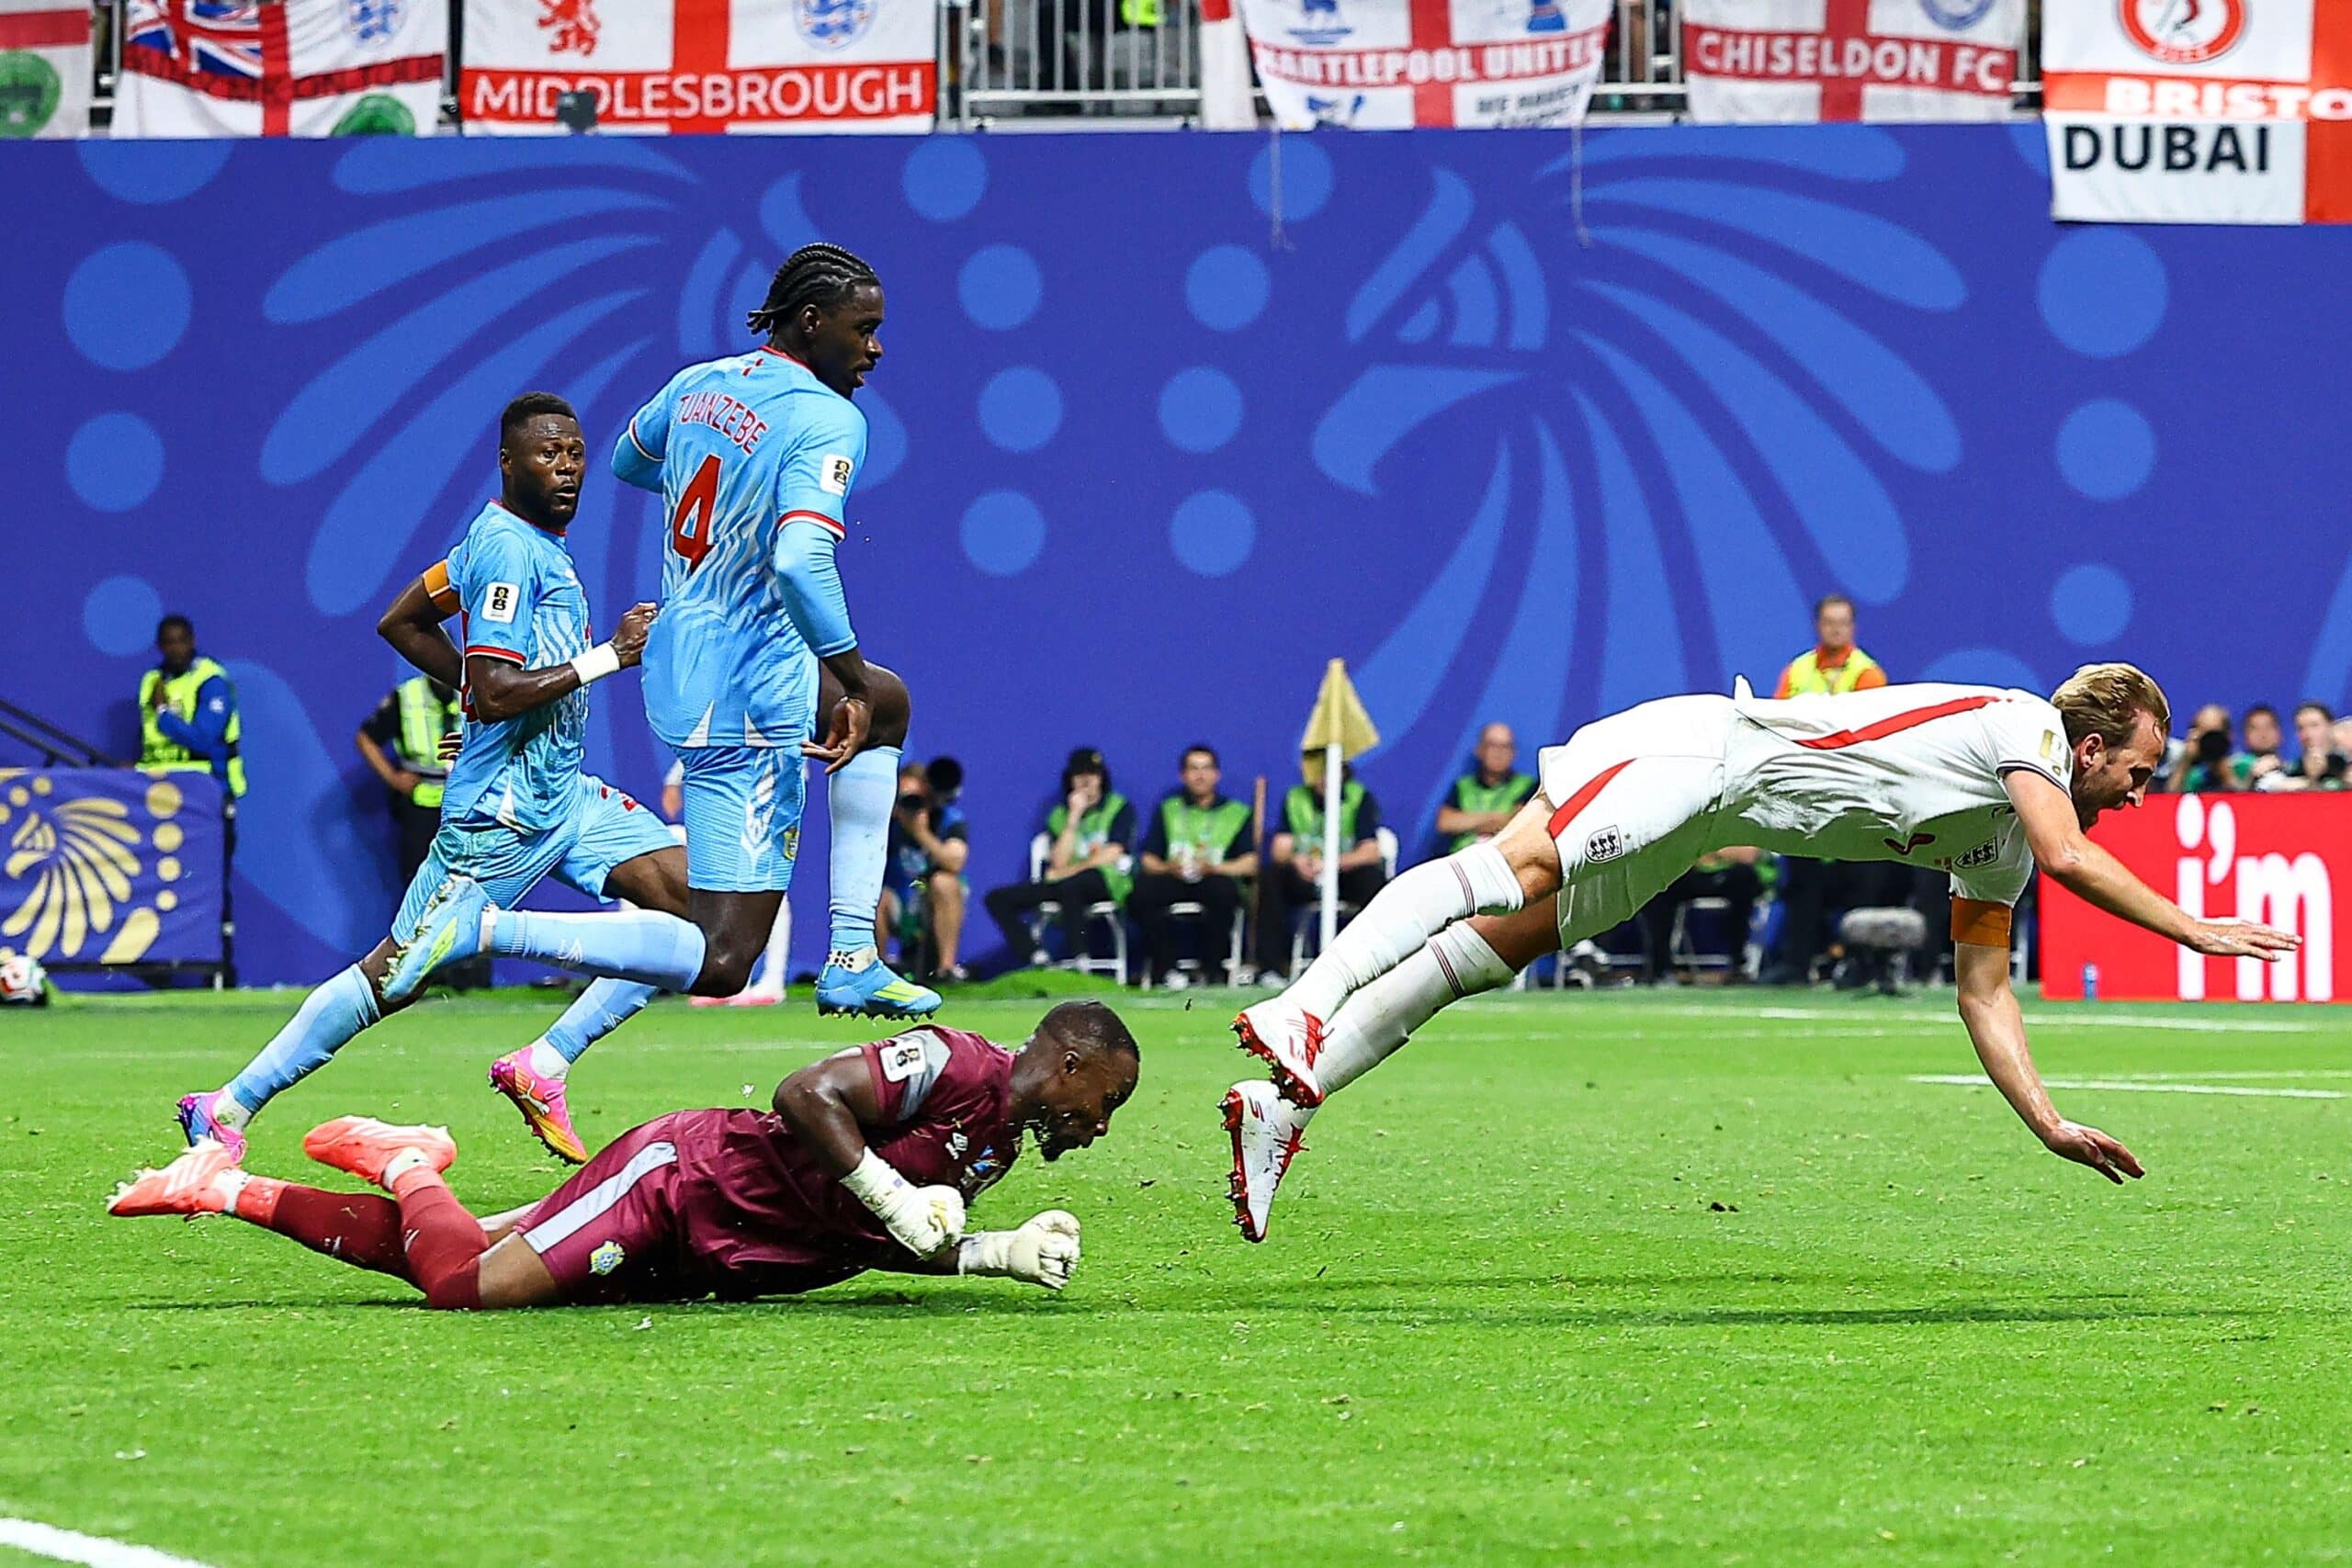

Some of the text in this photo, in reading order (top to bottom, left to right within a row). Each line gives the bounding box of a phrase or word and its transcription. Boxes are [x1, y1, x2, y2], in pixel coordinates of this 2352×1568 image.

[1695, 31, 2007, 90] CHISELDON FC
[2064, 125, 2270, 173] DUBAI
[678, 392, 769, 457] TUANZEBE
[673, 453, 723, 577] 4
